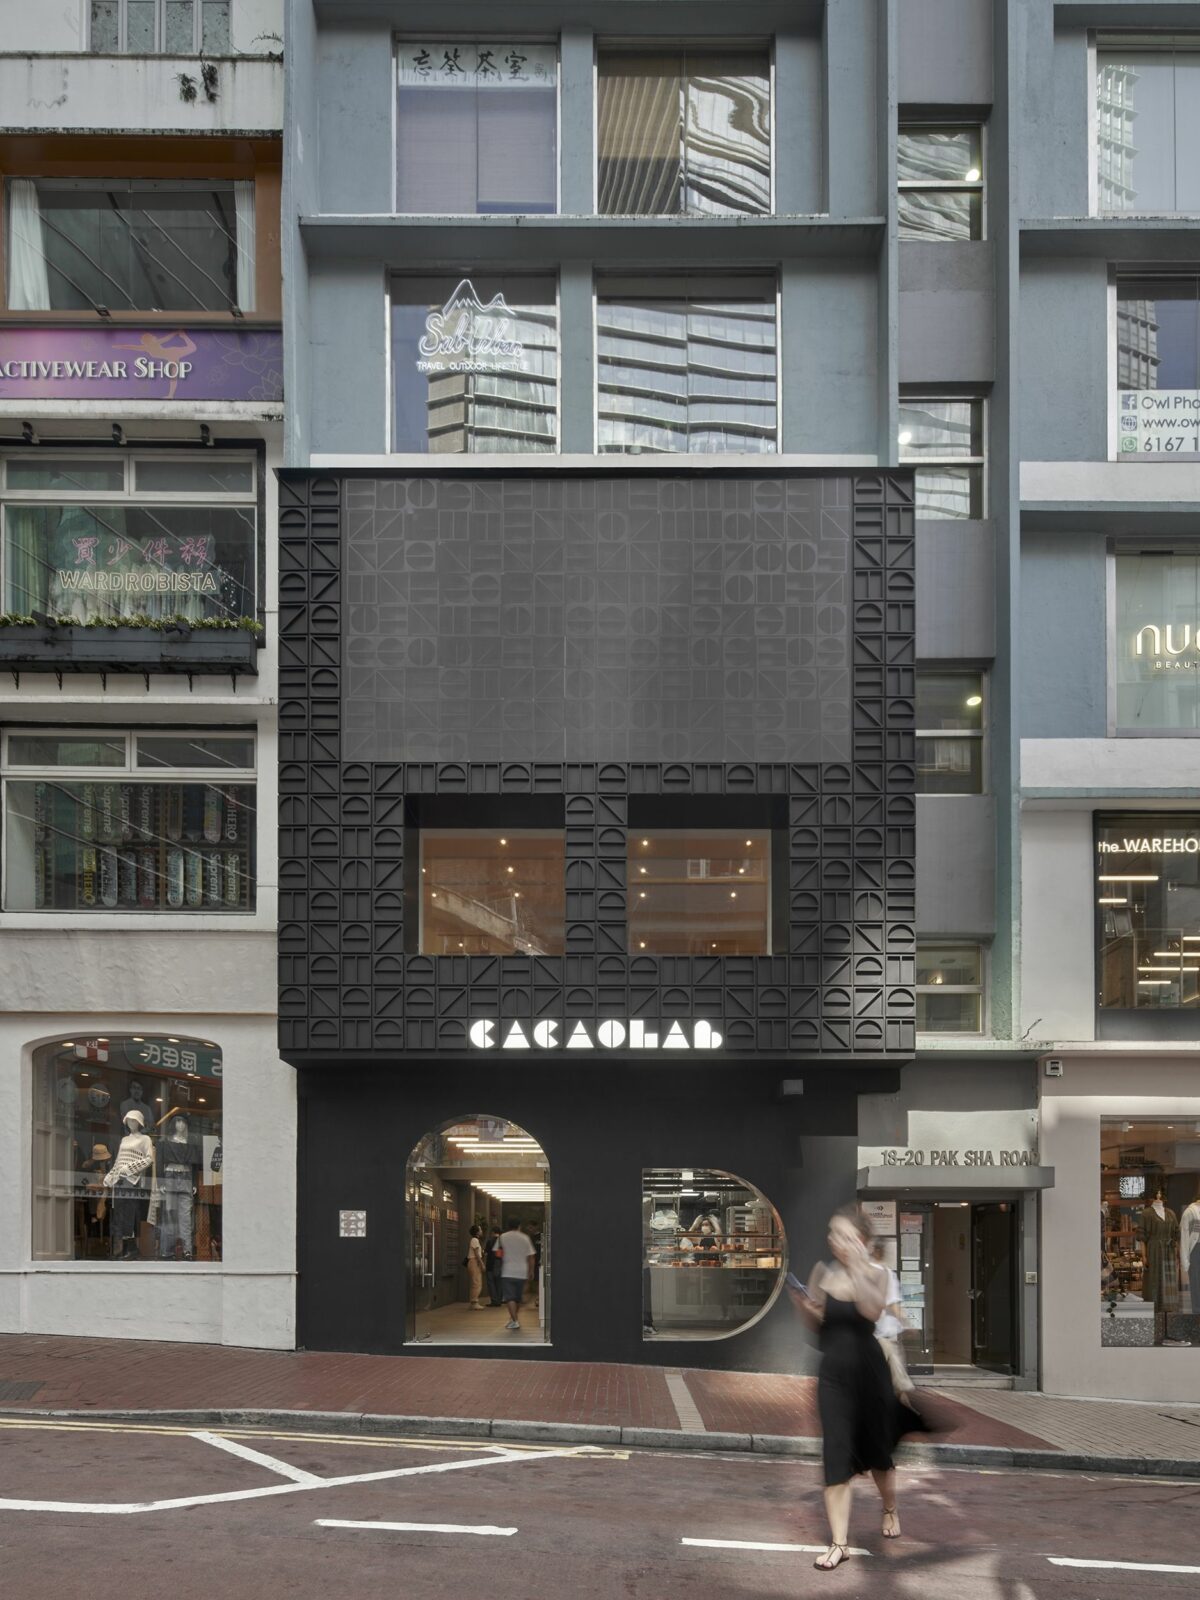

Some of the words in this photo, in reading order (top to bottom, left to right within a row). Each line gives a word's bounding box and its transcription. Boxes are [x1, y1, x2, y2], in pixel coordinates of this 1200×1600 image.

[0, 361, 127, 378] CTIVEWEAR
[417, 361, 446, 371] TRAVEL
[449, 361, 487, 371] OUTDOOR
[1141, 396, 1170, 410] Owl
[1174, 396, 1200, 410] Pho
[59, 570, 217, 591] WARDROBISTA
[102, 785, 114, 833] Supreme
[1098, 841, 1119, 853] the
[208, 853, 221, 901] Supreme
[470, 1020, 722, 1048] CACAOLAB
[881, 1150, 925, 1166] 18-20
[930, 1150, 960, 1166] PAK
[964, 1150, 995, 1166] SHA
[1000, 1150, 1041, 1166] ROAD
